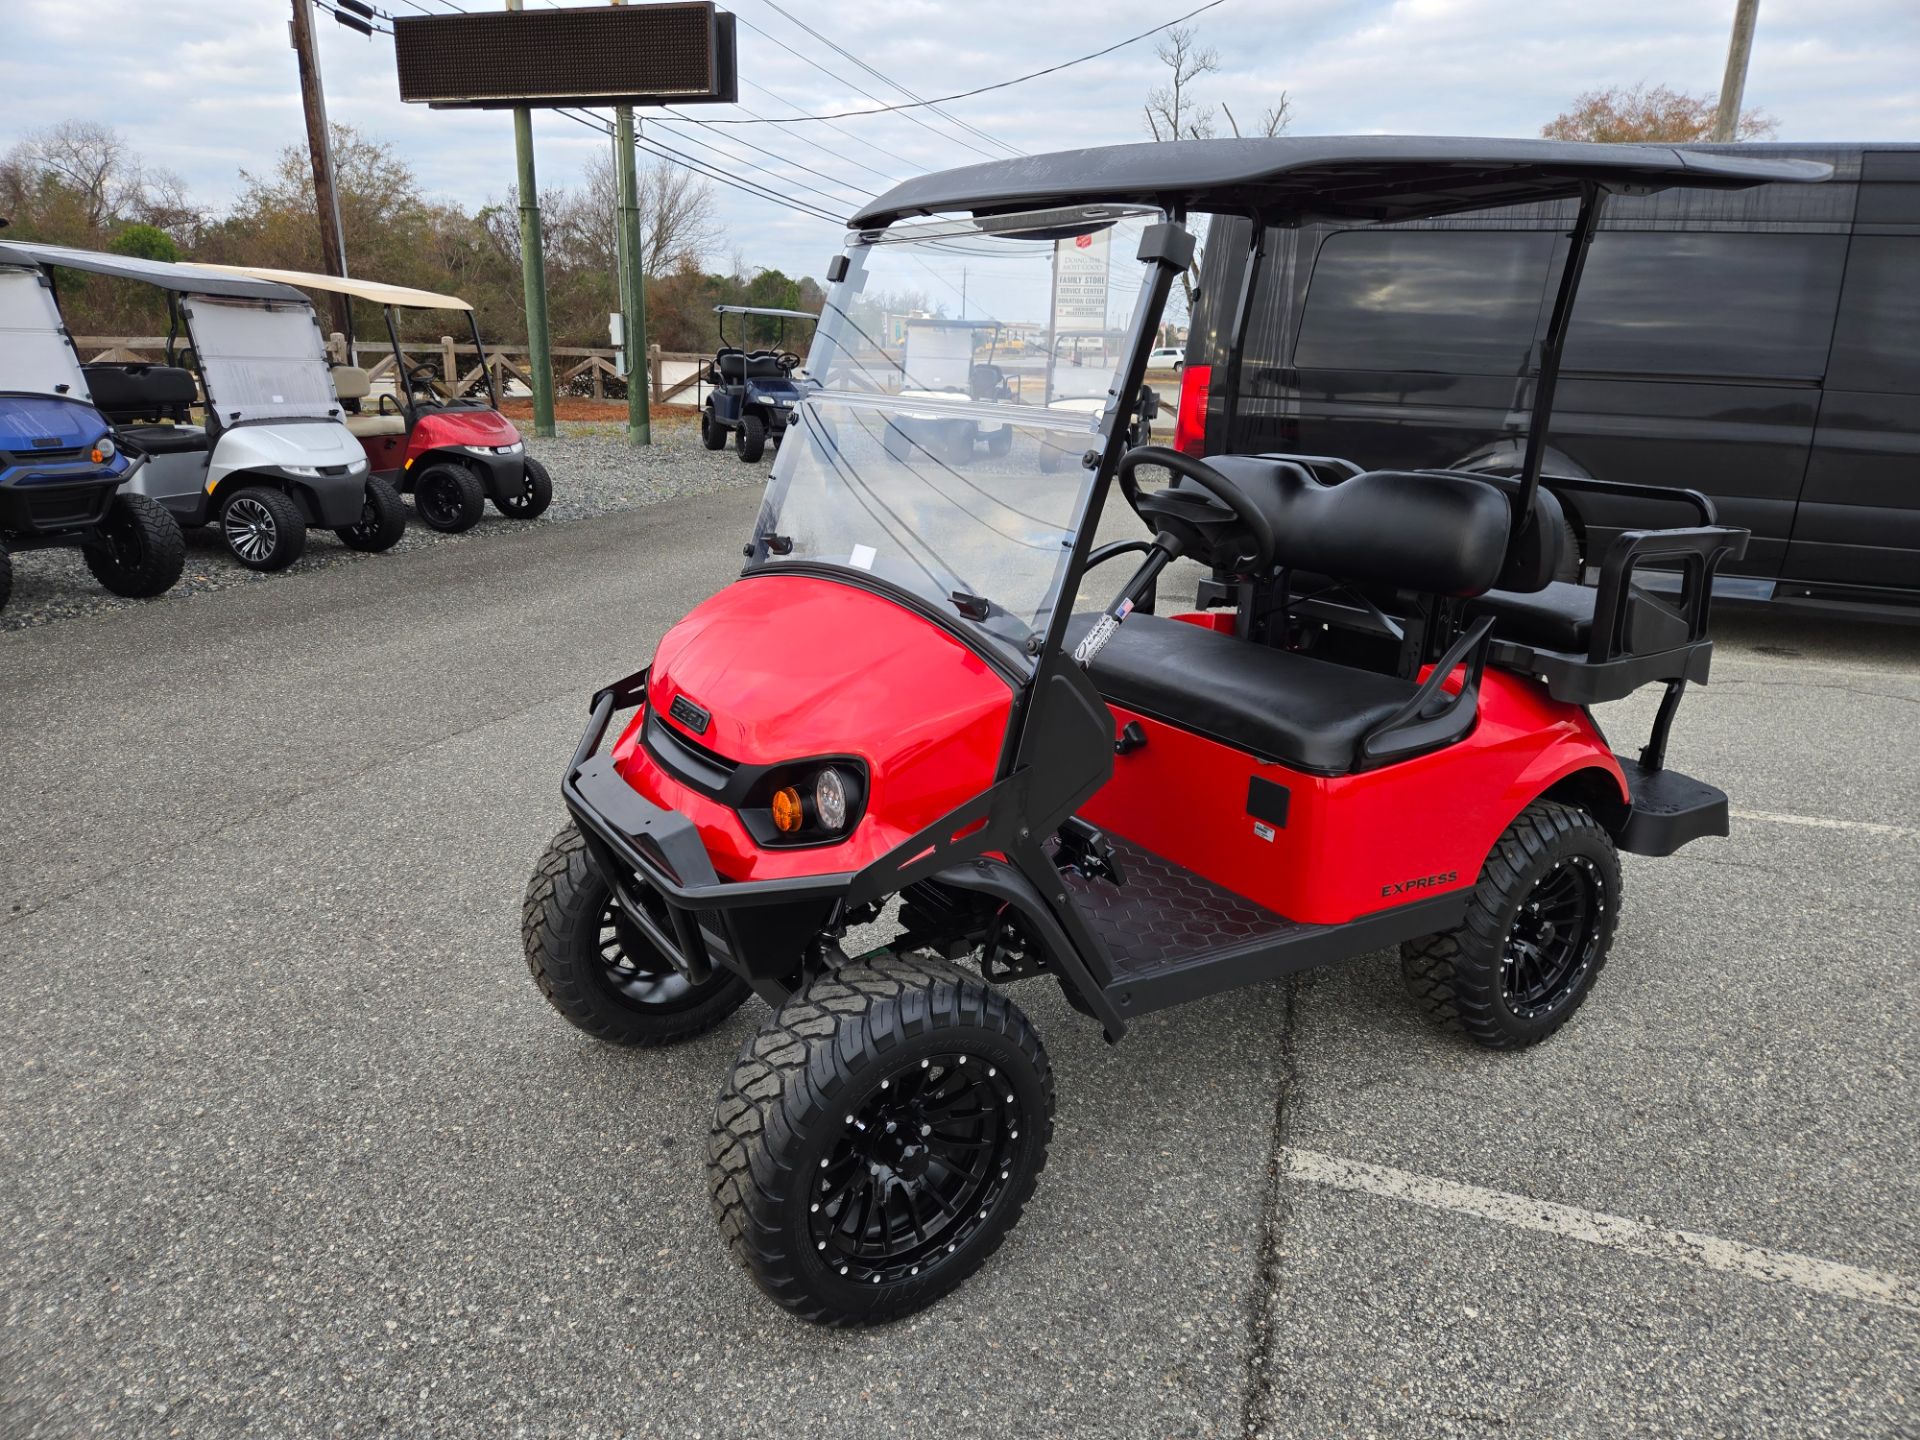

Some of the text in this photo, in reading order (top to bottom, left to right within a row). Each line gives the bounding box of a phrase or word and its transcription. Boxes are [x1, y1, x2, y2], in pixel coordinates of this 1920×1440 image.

[1059, 276, 1105, 284] FAMILY STORE
[1381, 871, 1457, 897] EXPRESS
